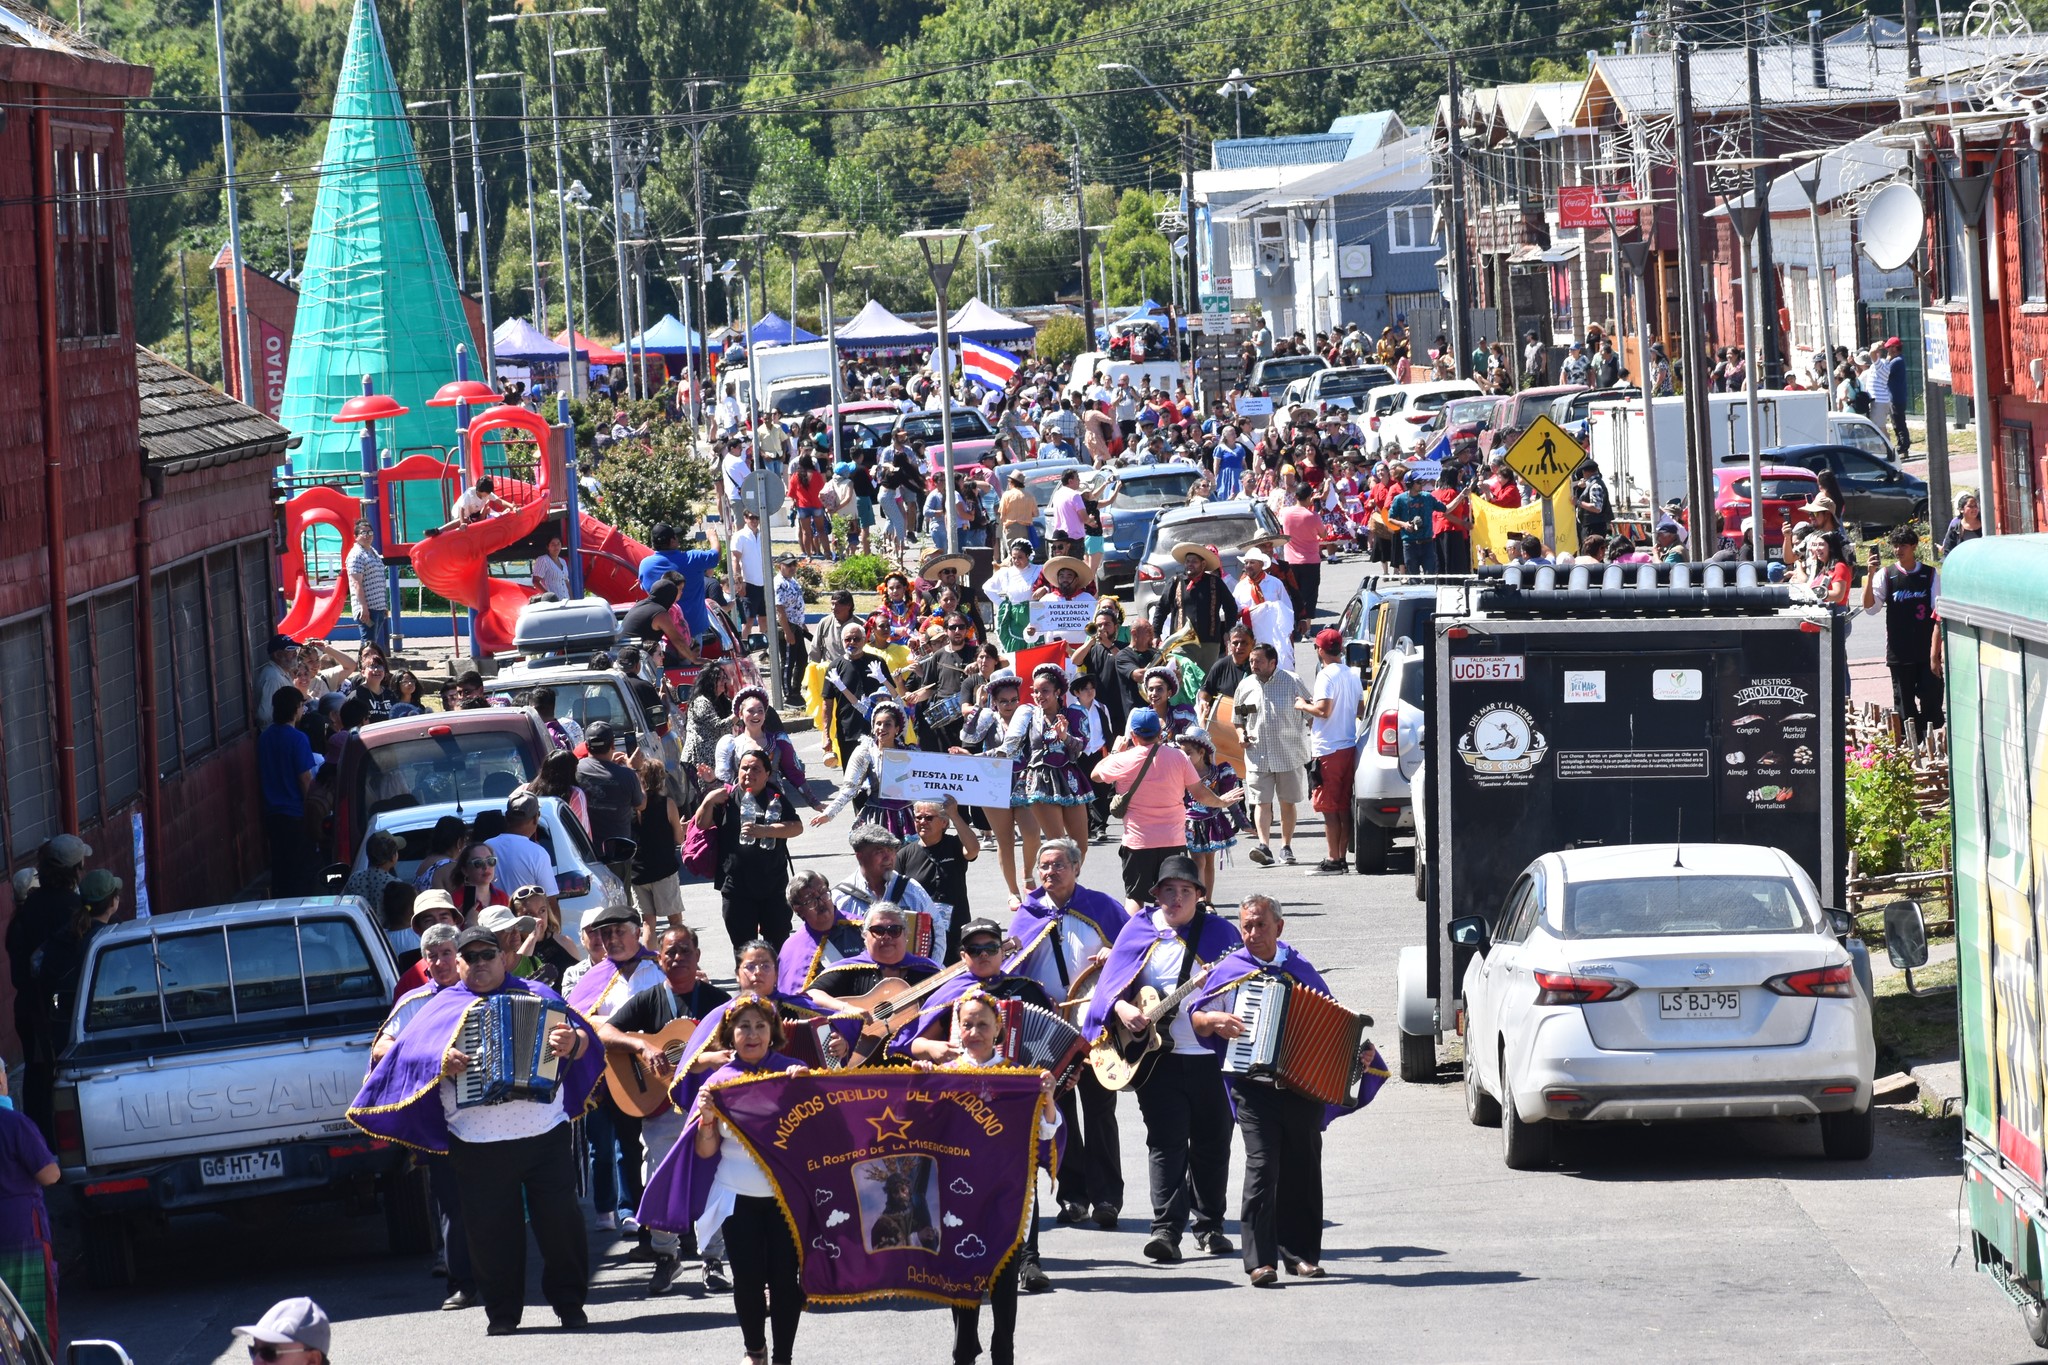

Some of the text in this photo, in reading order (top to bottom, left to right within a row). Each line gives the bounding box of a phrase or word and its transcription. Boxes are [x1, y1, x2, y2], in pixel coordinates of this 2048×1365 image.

[1564, 199, 1587, 207] Coca-Cola
[266, 336, 284, 417] ACHAO
[1516, 520, 1544, 532] LORET
[1914, 604, 1926, 621] 3
[1751, 678, 1792, 686] NUESTROS
[1743, 686, 1800, 700] PRODUCTOS
[1468, 714, 1482, 728] DEL
[1480, 702, 1496, 716] MAR
[1504, 702, 1514, 710] LA
[1515, 705, 1535, 727] TIERRA
[1736, 727, 1760, 735] Congrio
[1783, 726, 1807, 734] Merluza
[1478, 761, 1531, 770] LOS CHONOS
[912, 770, 979, 783] FIESTA DE LA
[1757, 768, 1781, 776] Cholgas
[923, 781, 964, 792] TIRANA
[120, 1070, 351, 1132] NISSAN
[773, 1088, 1004, 1150] MÚSICOS CABILDO DEL NAZARENO
